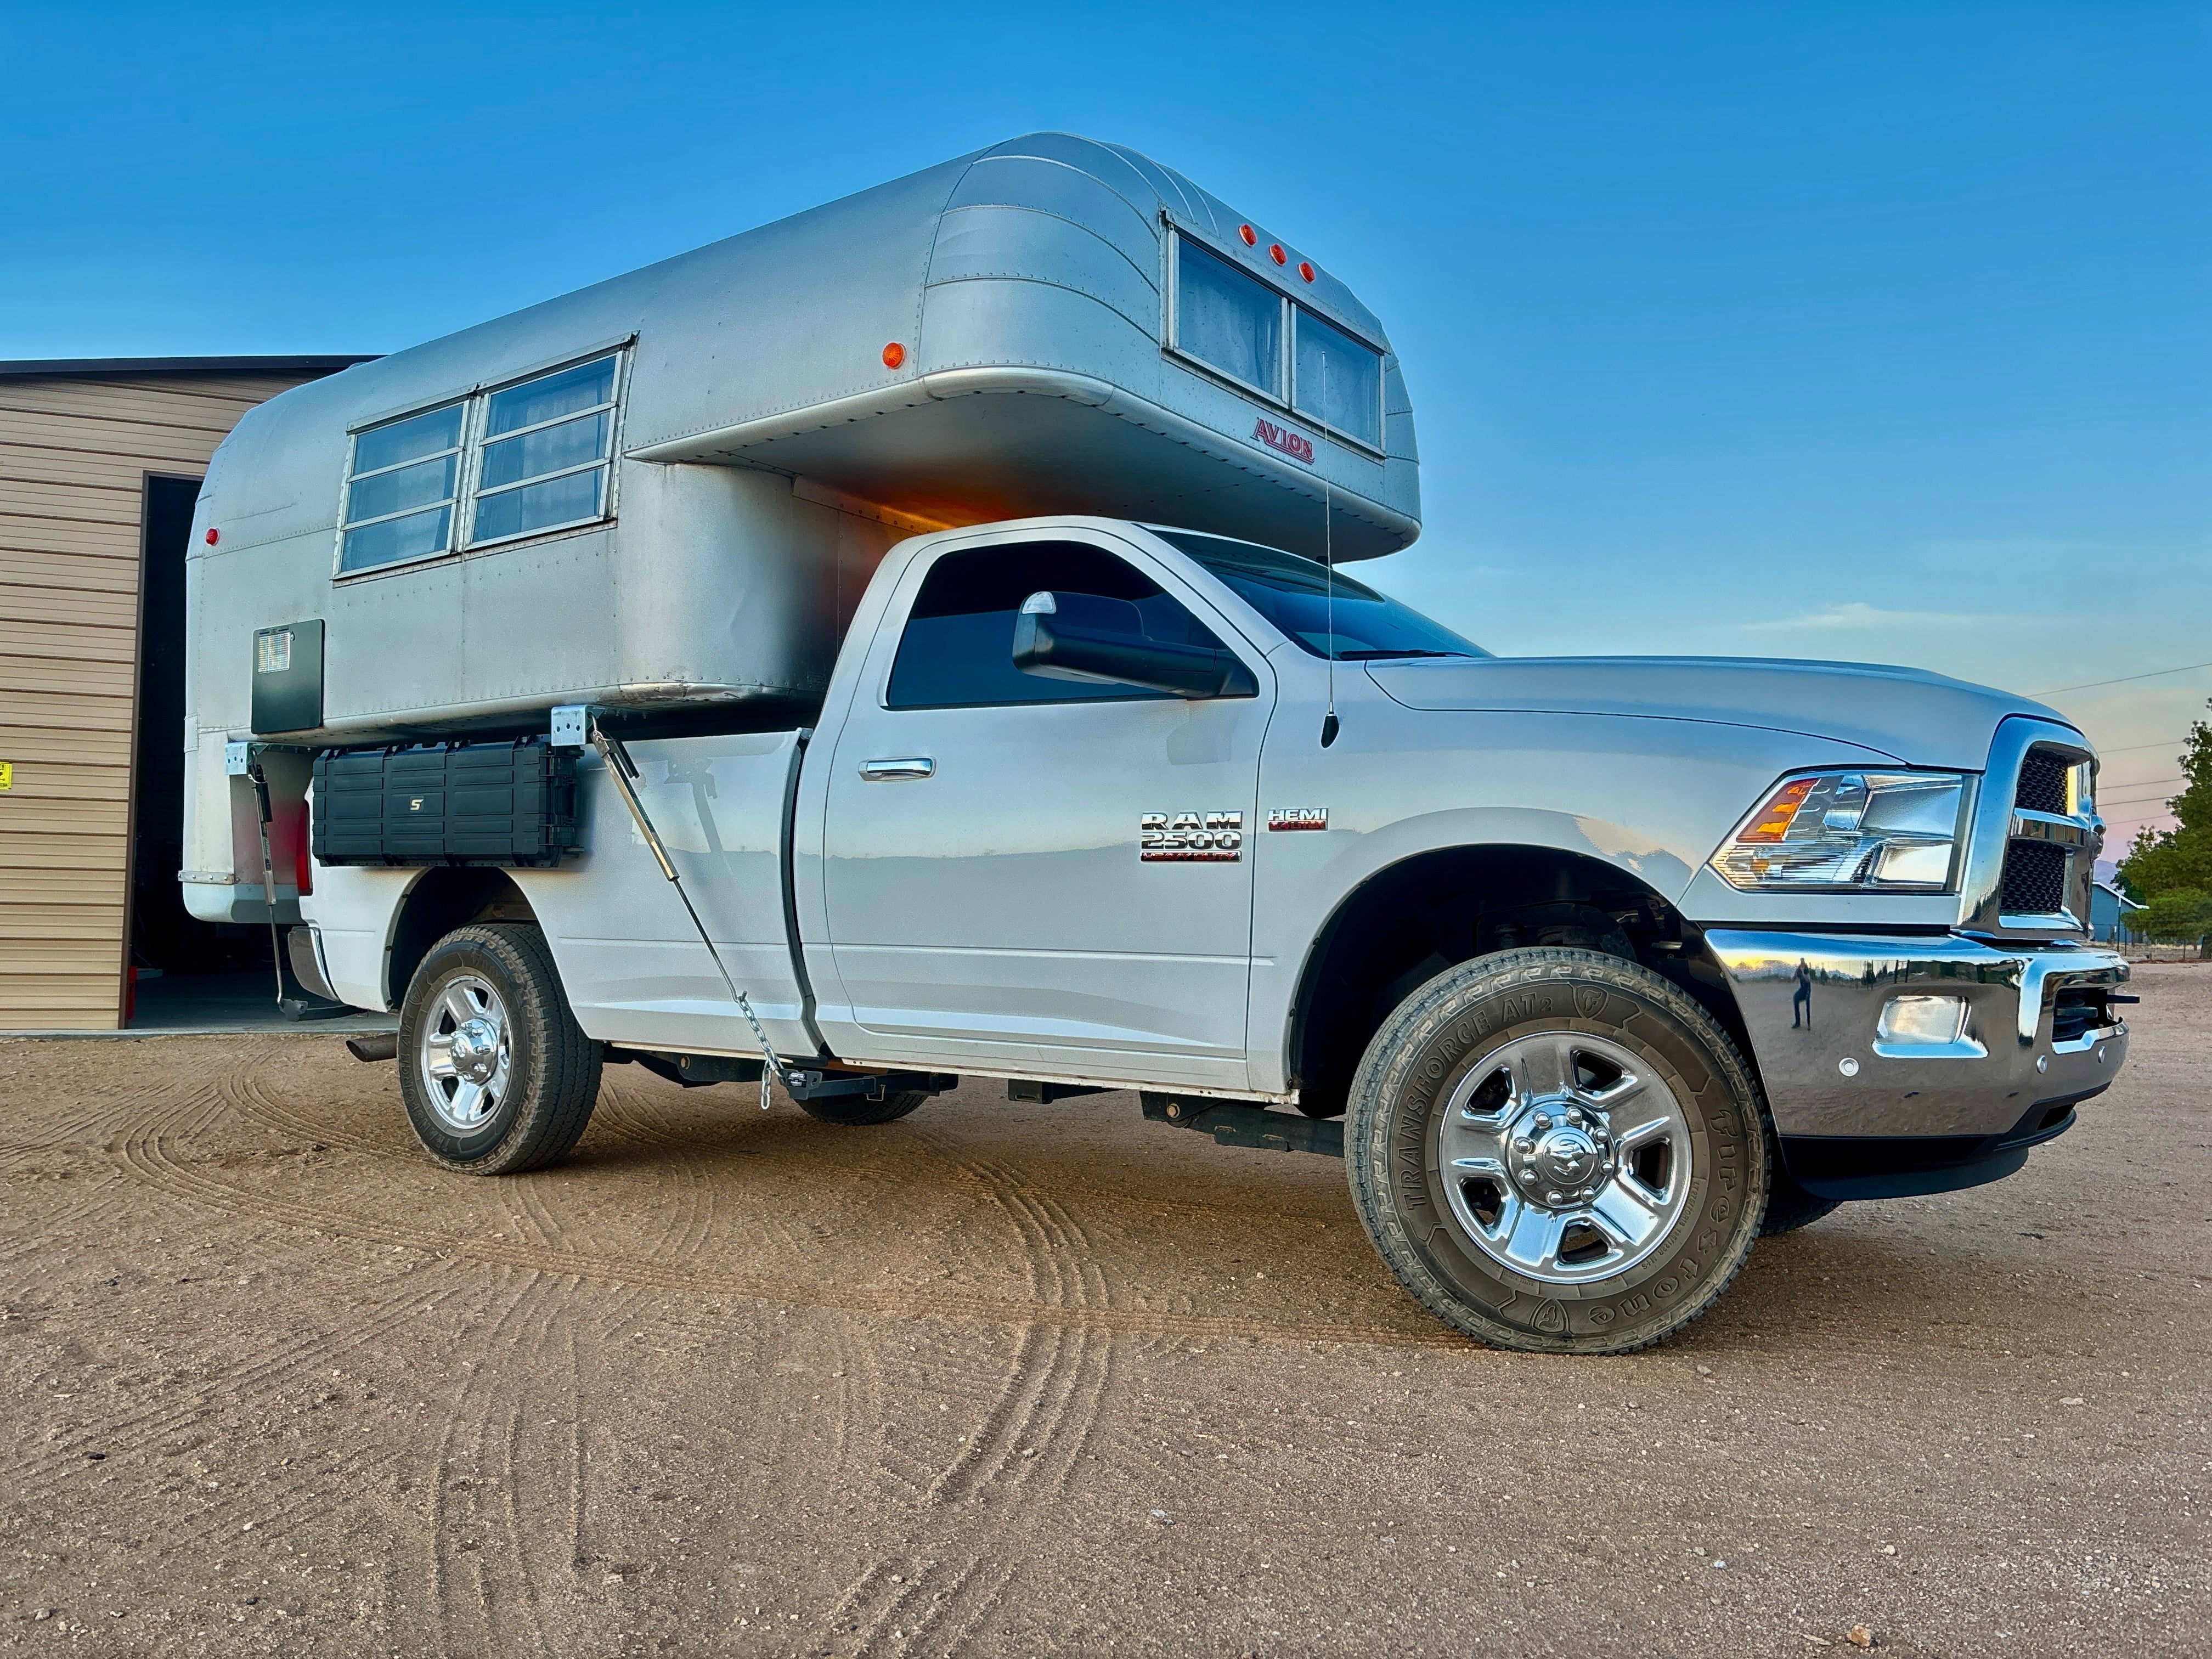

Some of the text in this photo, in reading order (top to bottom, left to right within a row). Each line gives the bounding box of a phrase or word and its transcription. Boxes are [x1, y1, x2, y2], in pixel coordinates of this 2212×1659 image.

[1250, 416, 1315, 465] AVION
[1142, 811, 1243, 830] RAM
[1268, 808, 1328, 821] HEMI
[1291, 821, 1324, 830] LITER
[1141, 831, 1243, 849] 2500
[1398, 1010, 1492, 1210] TRANSFORCE
[1589, 1110, 1738, 1325] Firestone
